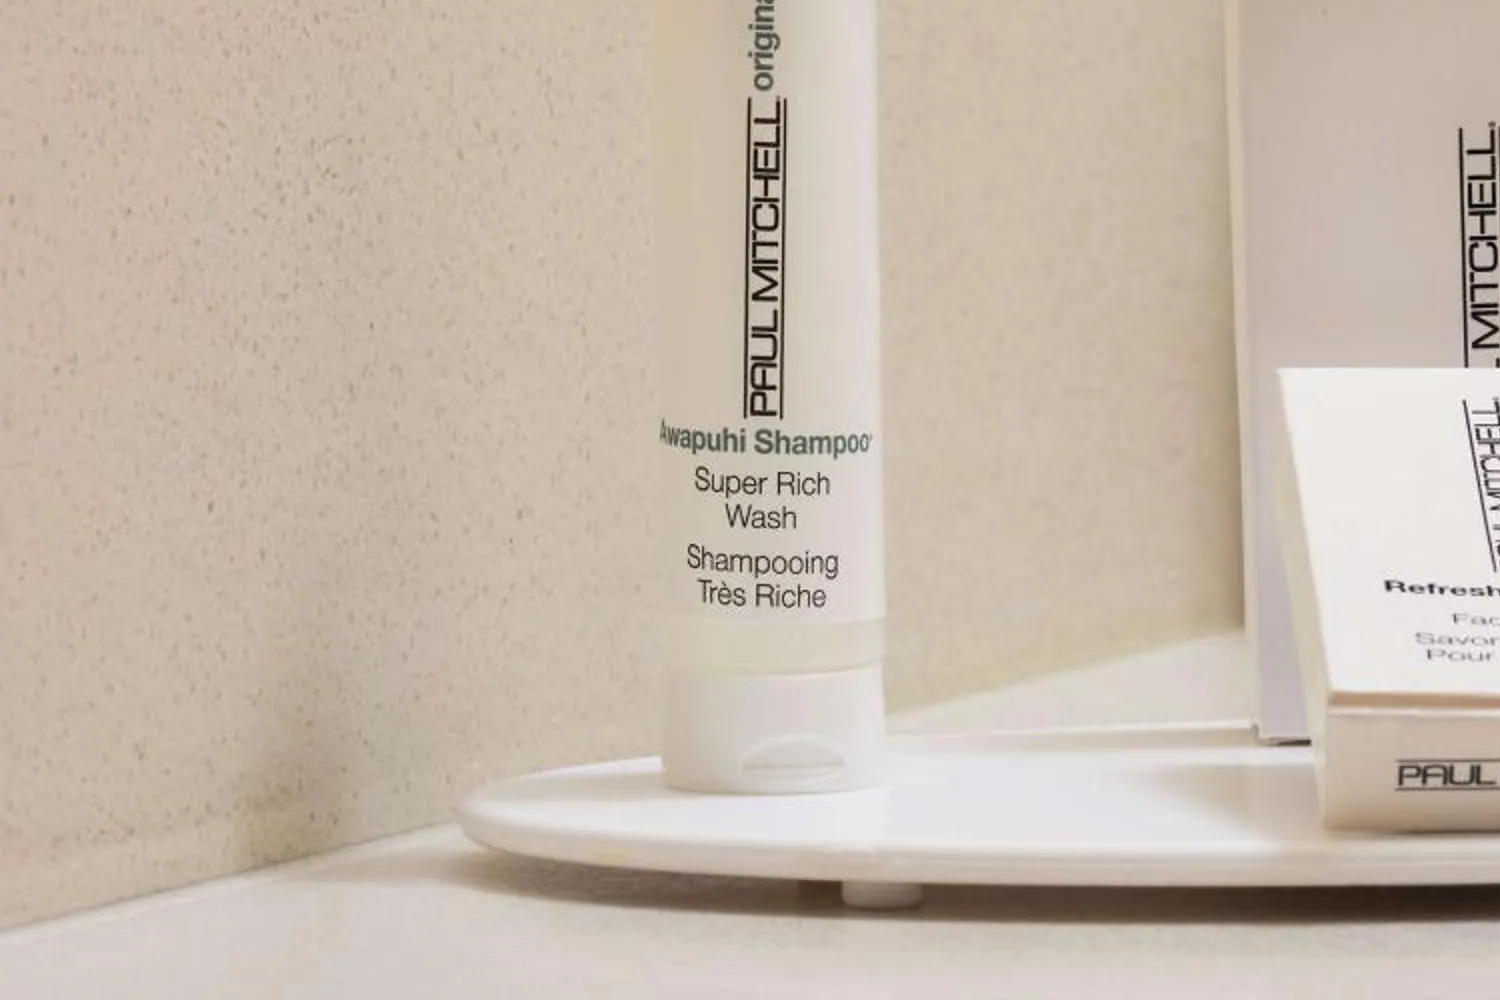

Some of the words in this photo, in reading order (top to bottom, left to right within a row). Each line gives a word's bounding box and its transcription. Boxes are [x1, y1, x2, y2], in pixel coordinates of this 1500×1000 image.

[750, 96, 781, 302] MITCHELL
[1466, 127, 1500, 350] MITCHELL
[750, 308, 779, 418] PAUL
[659, 418, 747, 455] Awapuhi
[753, 427, 870, 460] Shampoo
[694, 466, 769, 498] Super
[776, 470, 831, 496] Rich
[725, 503, 798, 530] Wash
[686, 543, 840, 579] Shampooing
[697, 578, 747, 607] Très
[755, 582, 828, 609] Riche
[1425, 648, 1494, 662] Pour
[1398, 764, 1498, 787] PAUL
